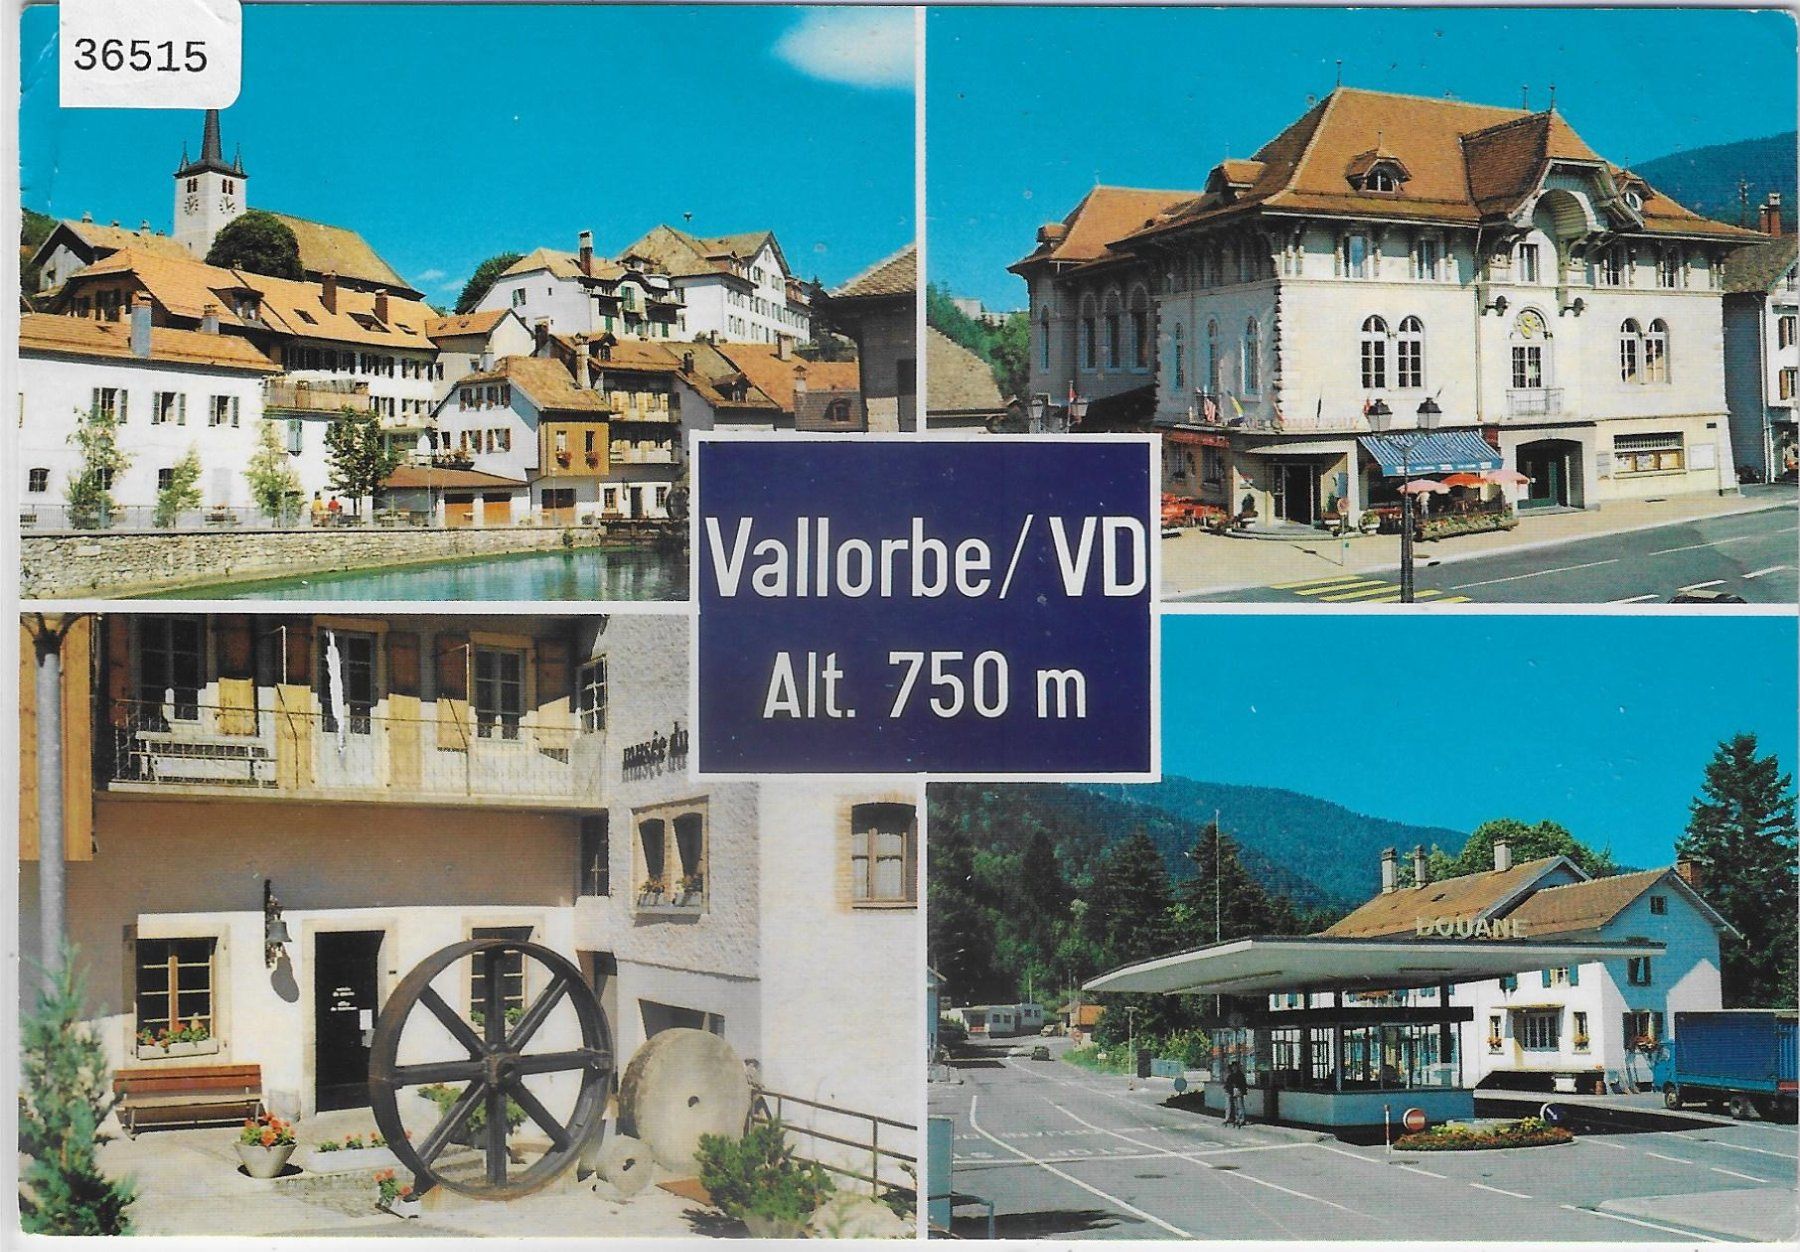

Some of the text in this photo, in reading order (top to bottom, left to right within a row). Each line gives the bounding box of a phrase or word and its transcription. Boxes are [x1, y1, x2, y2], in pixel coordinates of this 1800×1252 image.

[74, 37, 208, 73] 36515
[762, 650, 1087, 719] Alt. 750 m
[1416, 915, 1529, 939] DOUANE
